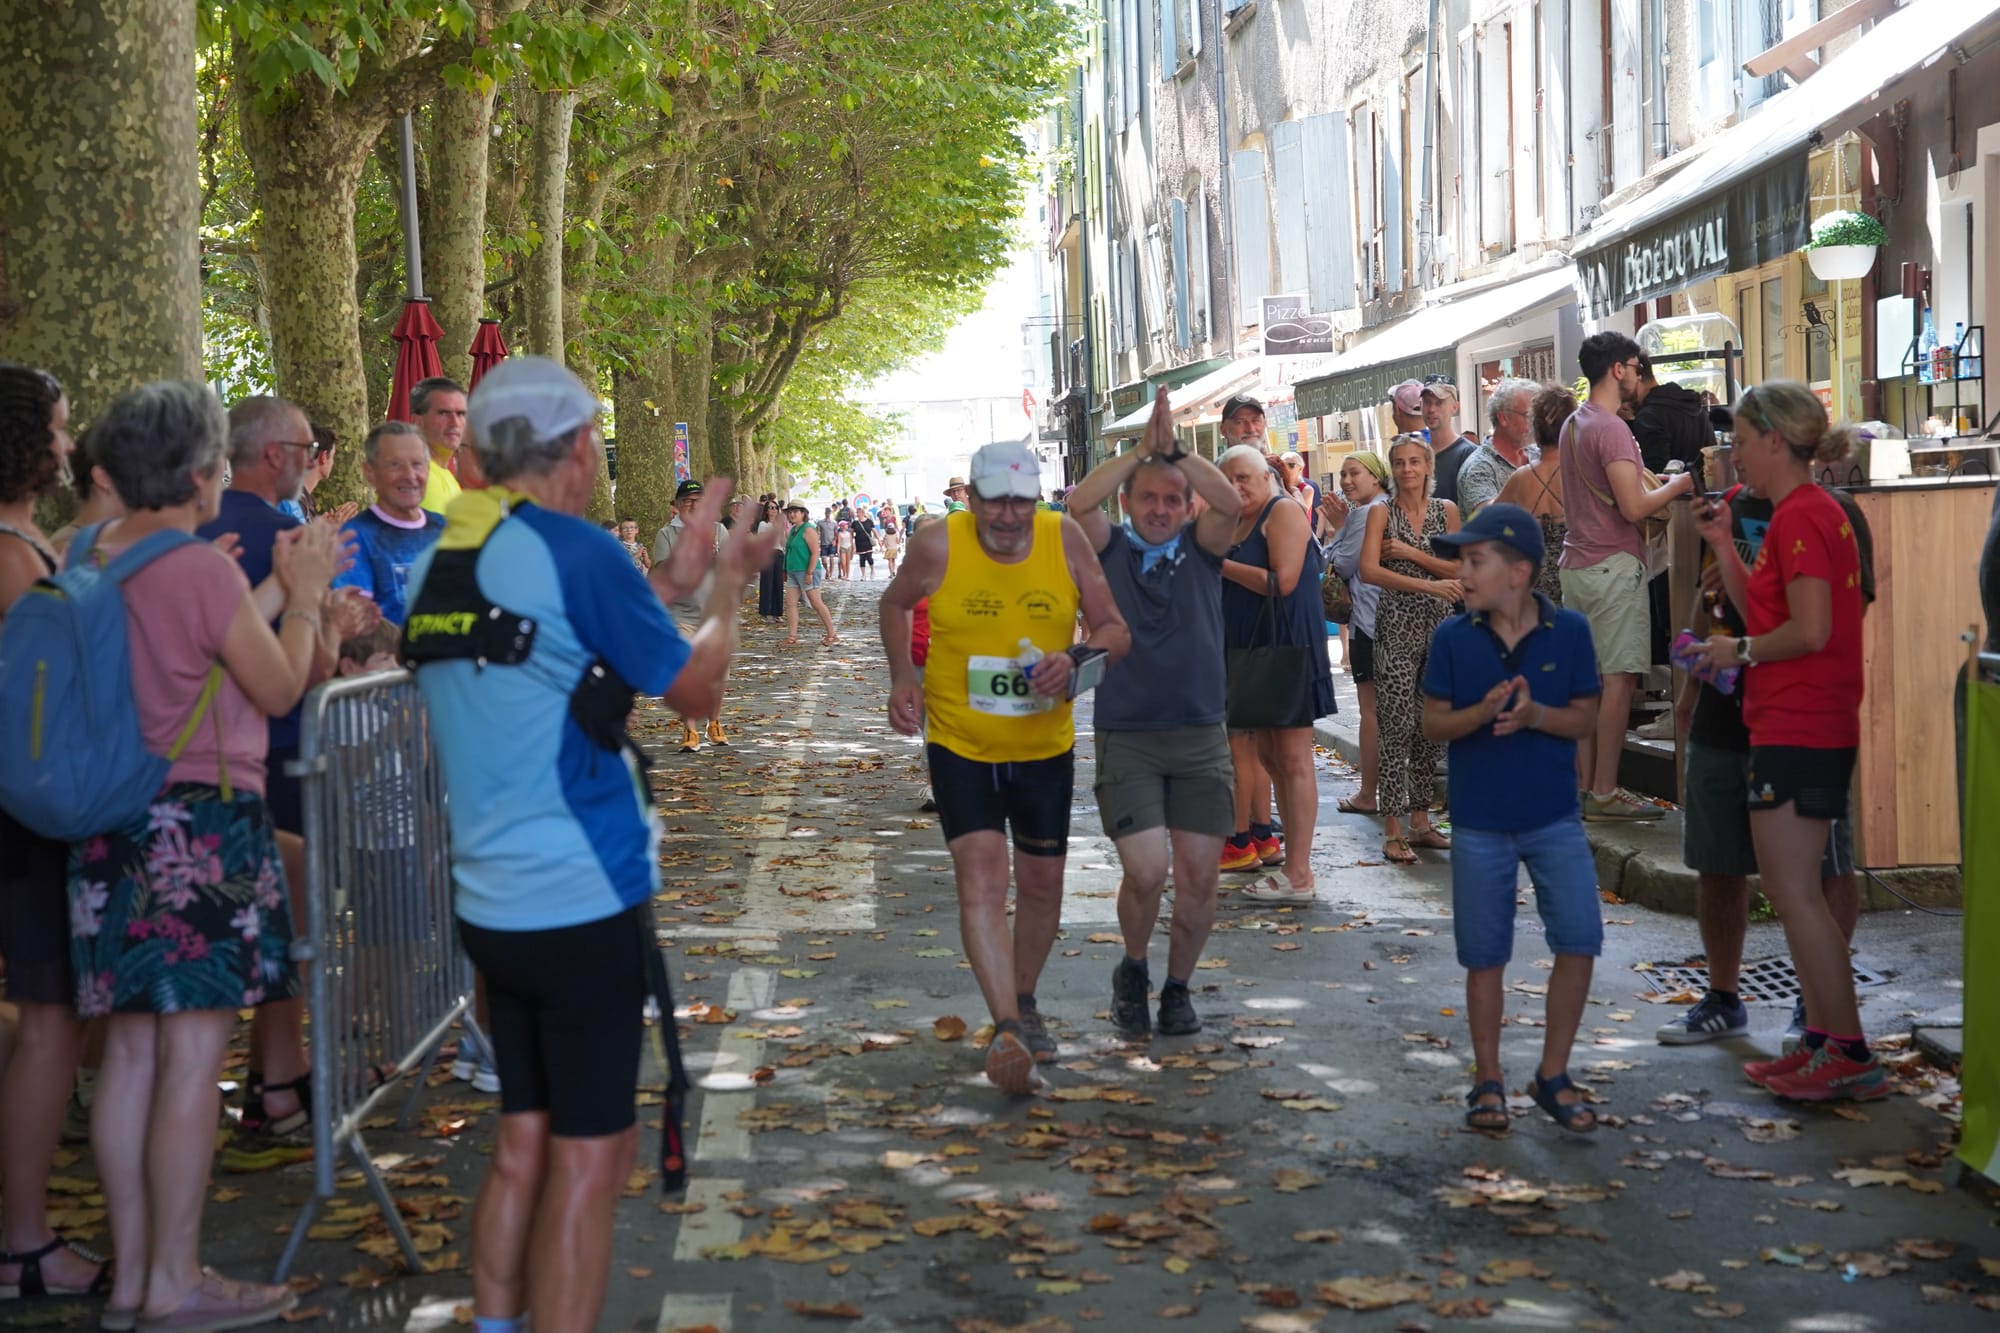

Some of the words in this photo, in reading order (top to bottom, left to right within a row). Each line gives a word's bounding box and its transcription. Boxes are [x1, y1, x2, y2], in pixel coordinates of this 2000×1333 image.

[1663, 233, 1686, 280] DU
[1689, 217, 1728, 269] VAL
[991, 674, 1029, 697] 66
